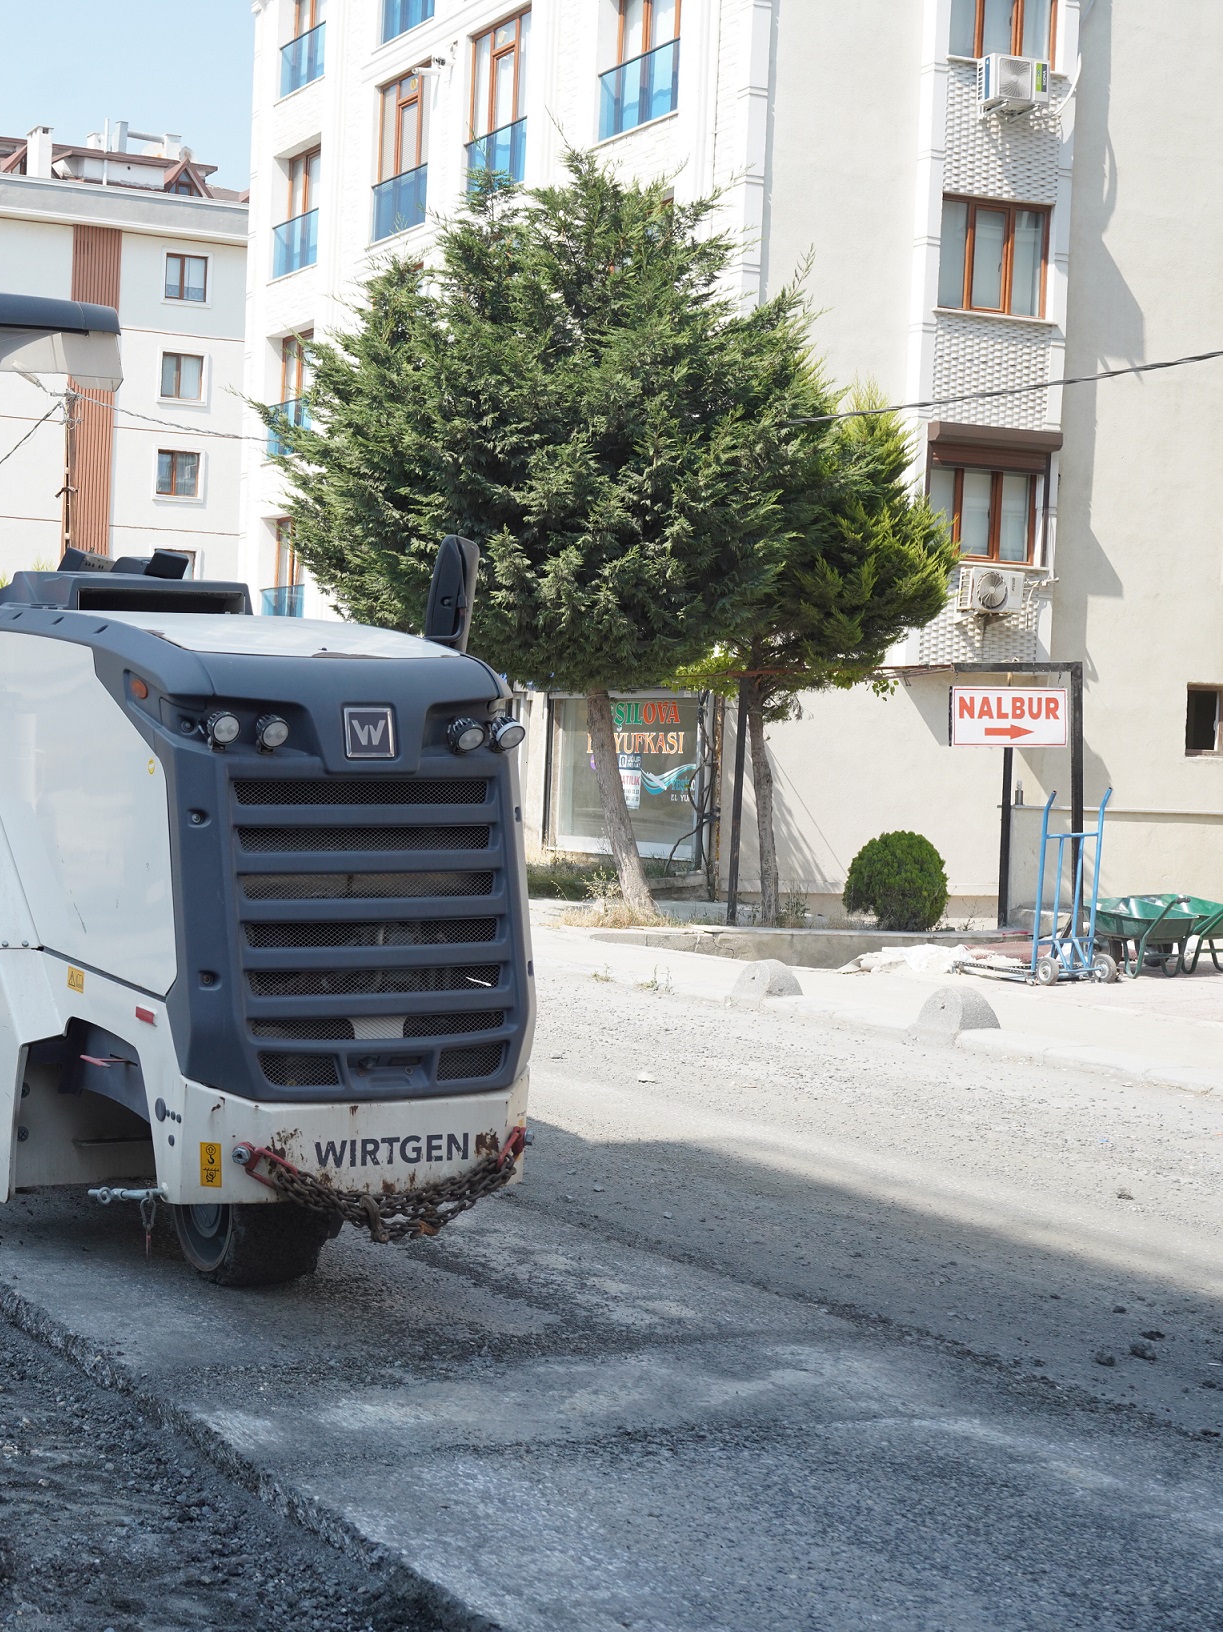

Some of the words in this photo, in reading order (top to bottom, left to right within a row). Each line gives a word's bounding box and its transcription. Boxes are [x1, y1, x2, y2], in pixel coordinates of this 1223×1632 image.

[958, 696, 1060, 720] NALBUR
[613, 731, 685, 755] YUFKASI
[621, 775, 641, 787] ATILIK
[314, 1132, 470, 1169] WIRTGEN
